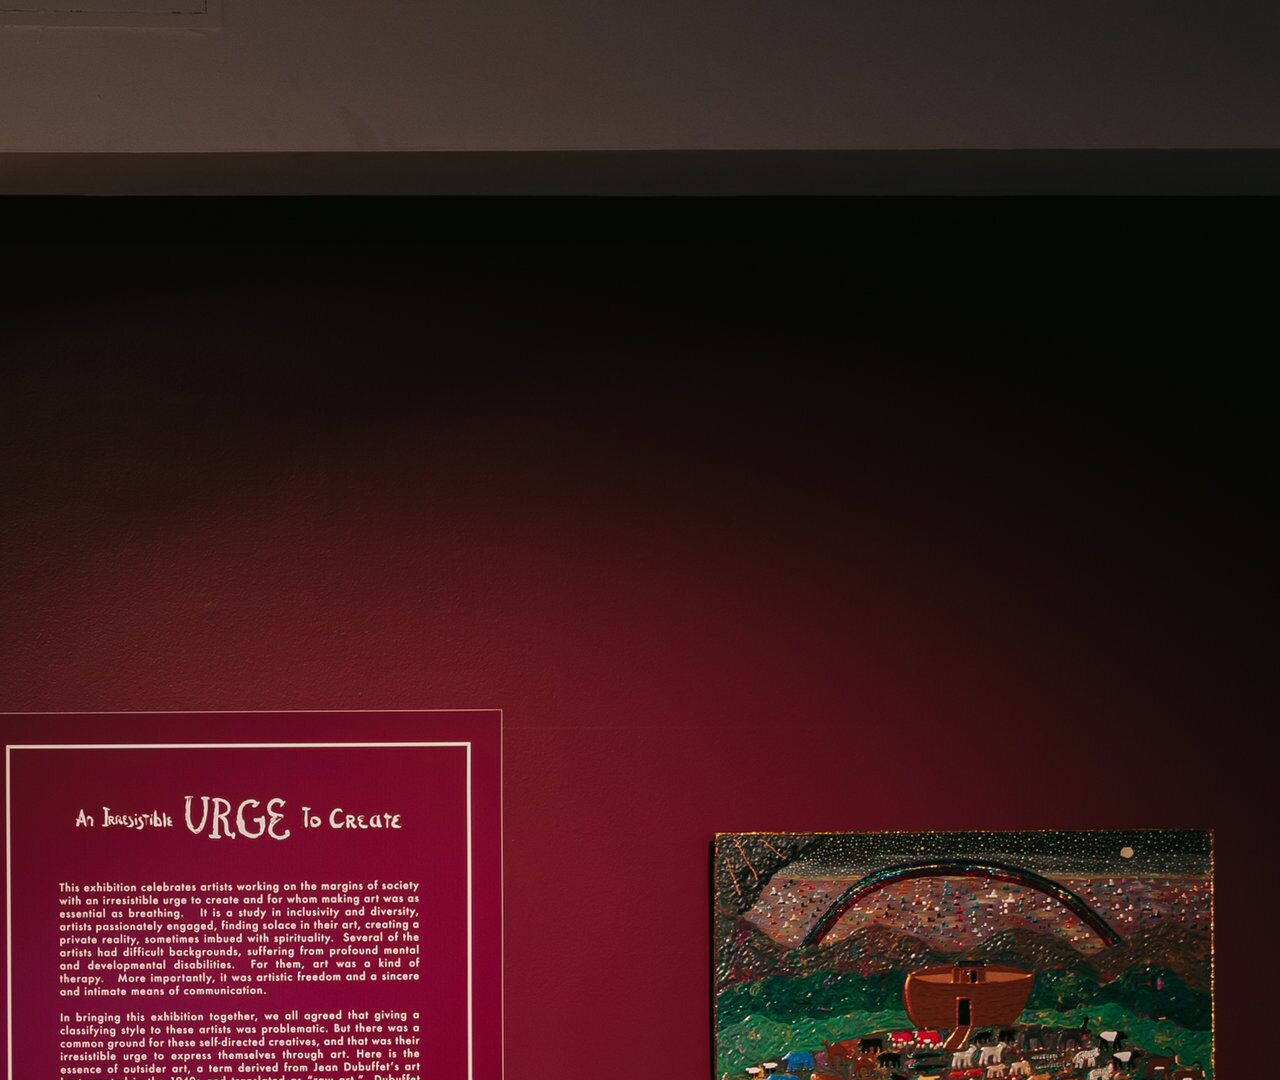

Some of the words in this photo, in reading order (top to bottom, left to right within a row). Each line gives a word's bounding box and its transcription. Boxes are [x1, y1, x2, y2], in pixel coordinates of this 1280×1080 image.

[75, 808, 94, 827] An
[184, 795, 290, 841] URGE
[301, 806, 320, 828] To
[59, 882, 80, 892] This
[84, 882, 136, 892] exhibition
[141, 881, 196, 891] celebrates
[200, 882, 232, 891] artists
[236, 881, 279, 893] working
[300, 880, 317, 890] the
[321, 881, 363, 893] margins
[367, 880, 378, 890] of
[382, 881, 419, 892] society
[59, 895, 81, 905] with
[103, 895, 158, 905] irresistible
[163, 898, 187, 907] urge
[191, 896, 201, 904] to
[206, 896, 239, 904] create
[243, 894, 263, 904] and
[267, 894, 283, 904] for
[287, 894, 317, 904] whom
[322, 893, 360, 906] making
[364, 895, 379, 903] art
[60, 908, 106, 918] essential
[128, 908, 183, 920] breathing.
[200, 908, 207, 917] It
[212, 908, 221, 917] is
[238, 907, 266, 919] study
[272, 908, 281, 916] in
[287, 906, 339, 919] inclusivity
[345, 906, 365, 916] and
[370, 905, 418, 918] diversity,
[60, 922, 92, 931] artists
[96, 921, 163, 933] passionately
[167, 920, 217, 933] engaged,
[221, 920, 258, 932] finding
[263, 920, 296, 929] solace
[300, 920, 310, 929] in
[314, 919, 338, 929] their
[342, 921, 360, 930] art,
[365, 920, 408, 931] creating
[60, 935, 97, 946] private
[102, 934, 139, 946] reality,
[145, 934, 199, 943] sometimes
[204, 933, 242, 943] imbued
[247, 933, 269, 943] with
[274, 932, 334, 945] spirituality.
[343, 932, 383, 942] Several
[388, 931, 398, 942] of
[403, 931, 419, 941] the
[60, 1013, 70, 1022] In
[76, 1012, 120, 1024] bringing
[127, 1012, 145, 1022] this
[151, 1011, 203, 1021] exhibition
[210, 1011, 258, 1023] together,
[285, 1010, 298, 1020] all
[304, 1010, 342, 1022] agreed
[348, 1010, 368, 1020] that
[374, 1010, 407, 1022] giving
[60, 1025, 116, 1037] classifying
[121, 1025, 146, 1037] style
[150, 1026, 161, 1034] to
[166, 1024, 194, 1034] these
[199, 1025, 231, 1034] artists
[262, 1023, 328, 1035] problematic.
[334, 1023, 350, 1033] But
[355, 1022, 382, 1032] there
[107, 1038, 145, 1050] ground
[149, 1037, 164, 1047] for
[168, 1037, 196, 1047] these
[200, 1036, 265, 1047] self-directed
[269, 1037, 320, 1047] creatives,
[324, 1036, 344, 1045] and
[347, 1036, 368, 1046] that
[395, 1035, 420, 1045] their
